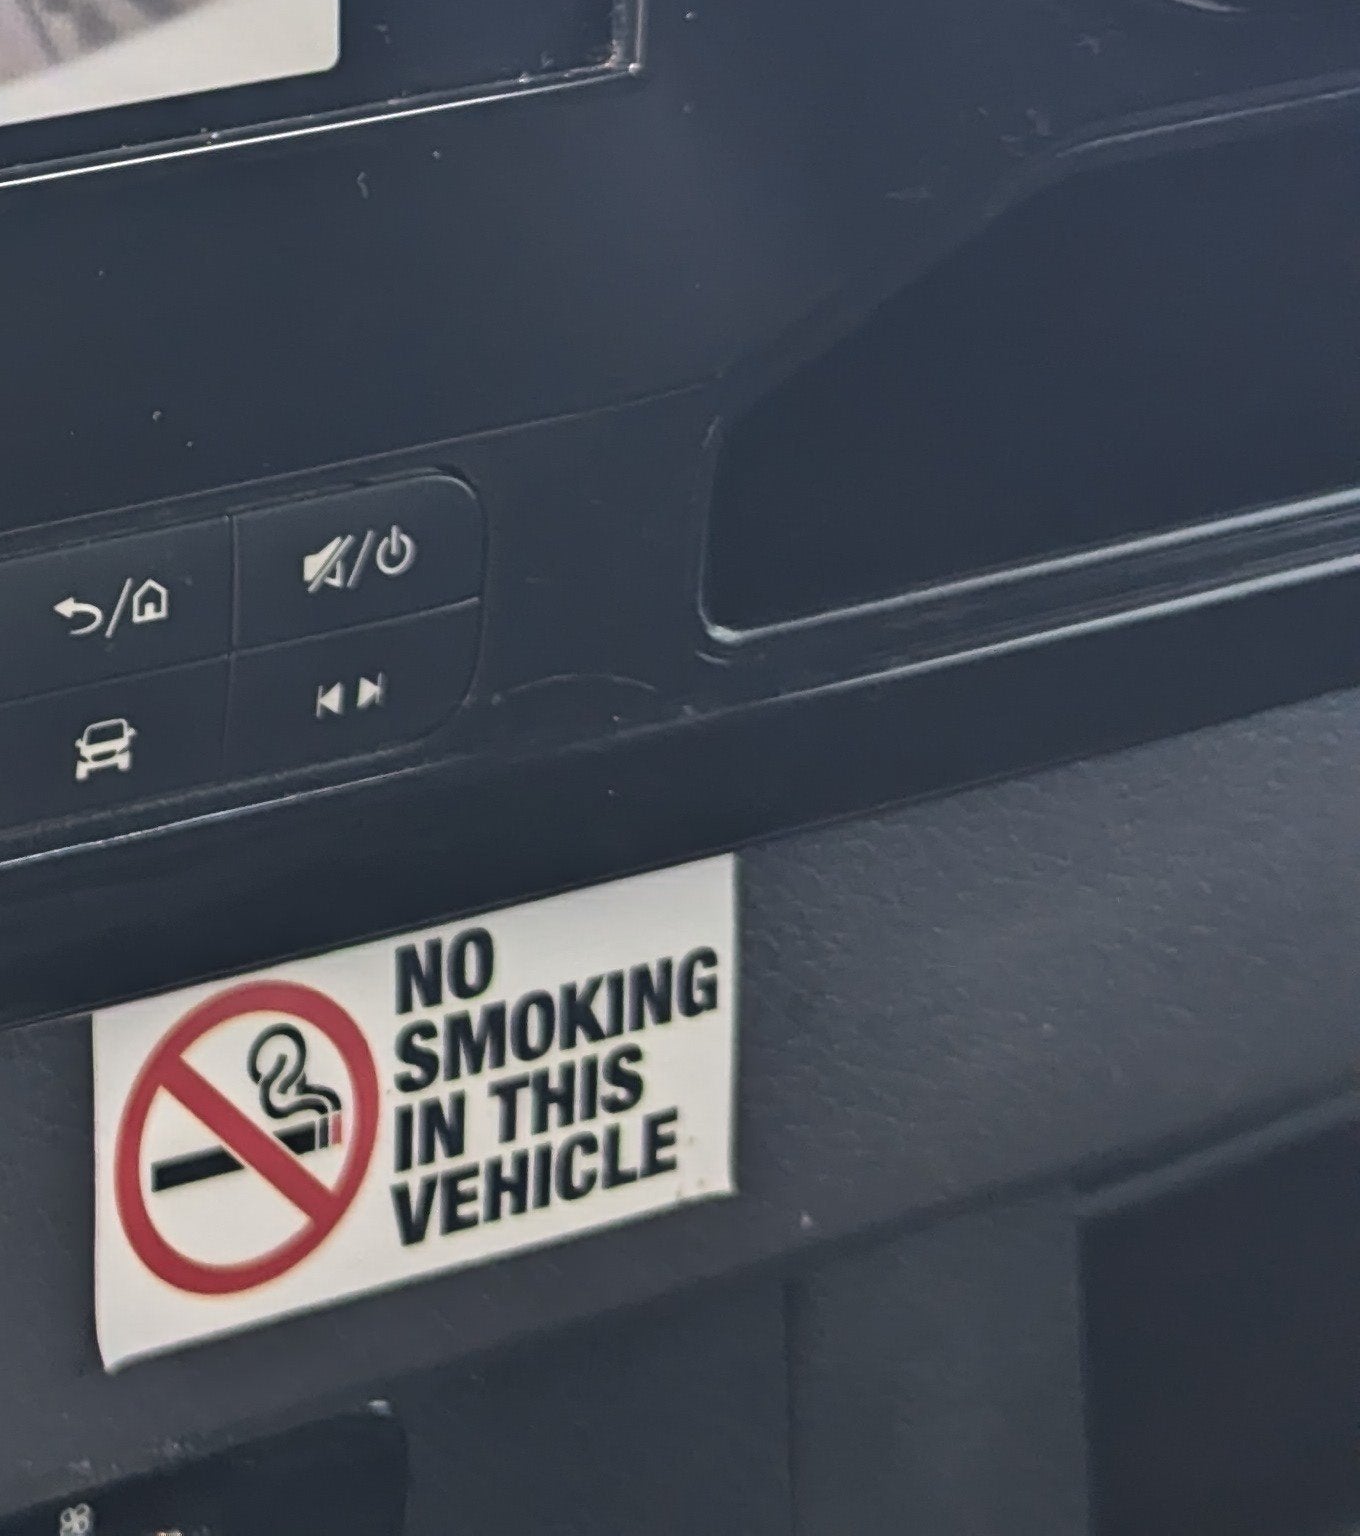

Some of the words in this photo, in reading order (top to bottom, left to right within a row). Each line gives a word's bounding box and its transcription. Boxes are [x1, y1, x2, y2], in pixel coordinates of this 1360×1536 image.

[393, 946, 719, 1095] SMOKING
[394, 926, 496, 1016] NO
[394, 1094, 466, 1173] IN
[489, 1042, 646, 1145] THIS
[390, 1107, 679, 1248] VEHICLE
